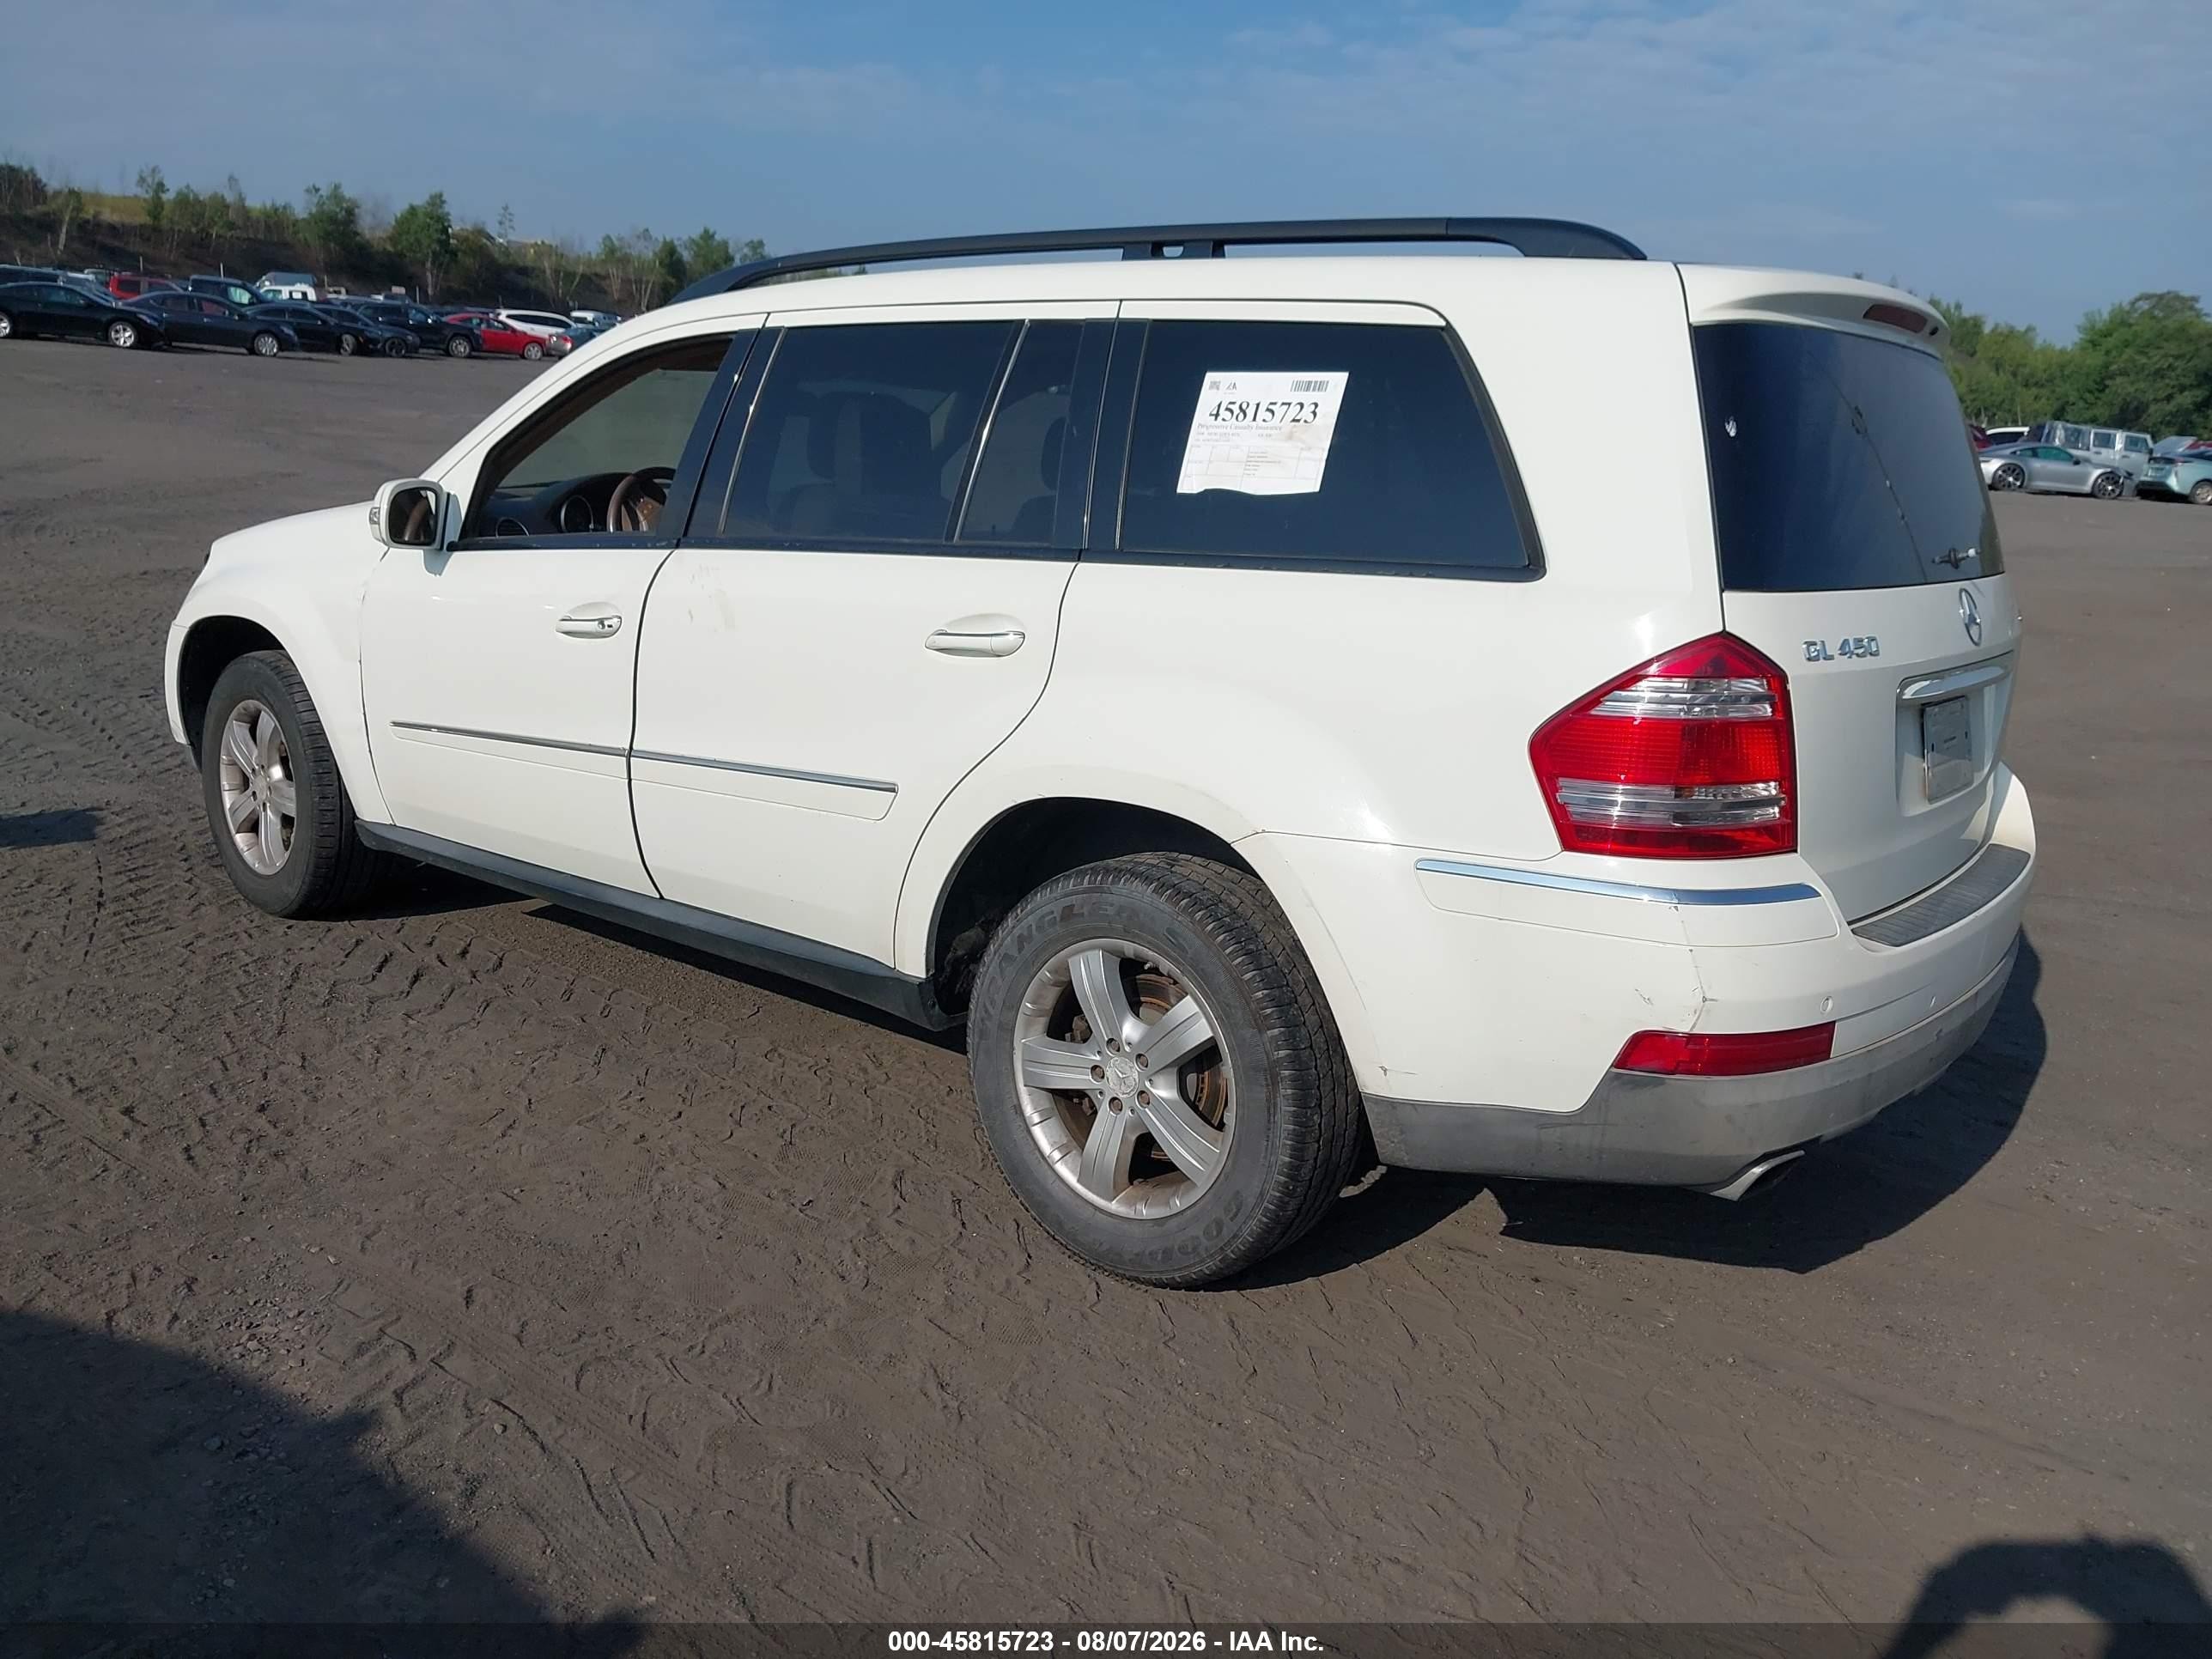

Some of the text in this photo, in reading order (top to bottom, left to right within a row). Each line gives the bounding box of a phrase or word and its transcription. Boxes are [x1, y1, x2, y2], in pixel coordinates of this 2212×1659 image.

[1208, 400, 1319, 423] 45815723
[1802, 635, 1880, 661] GL 450
